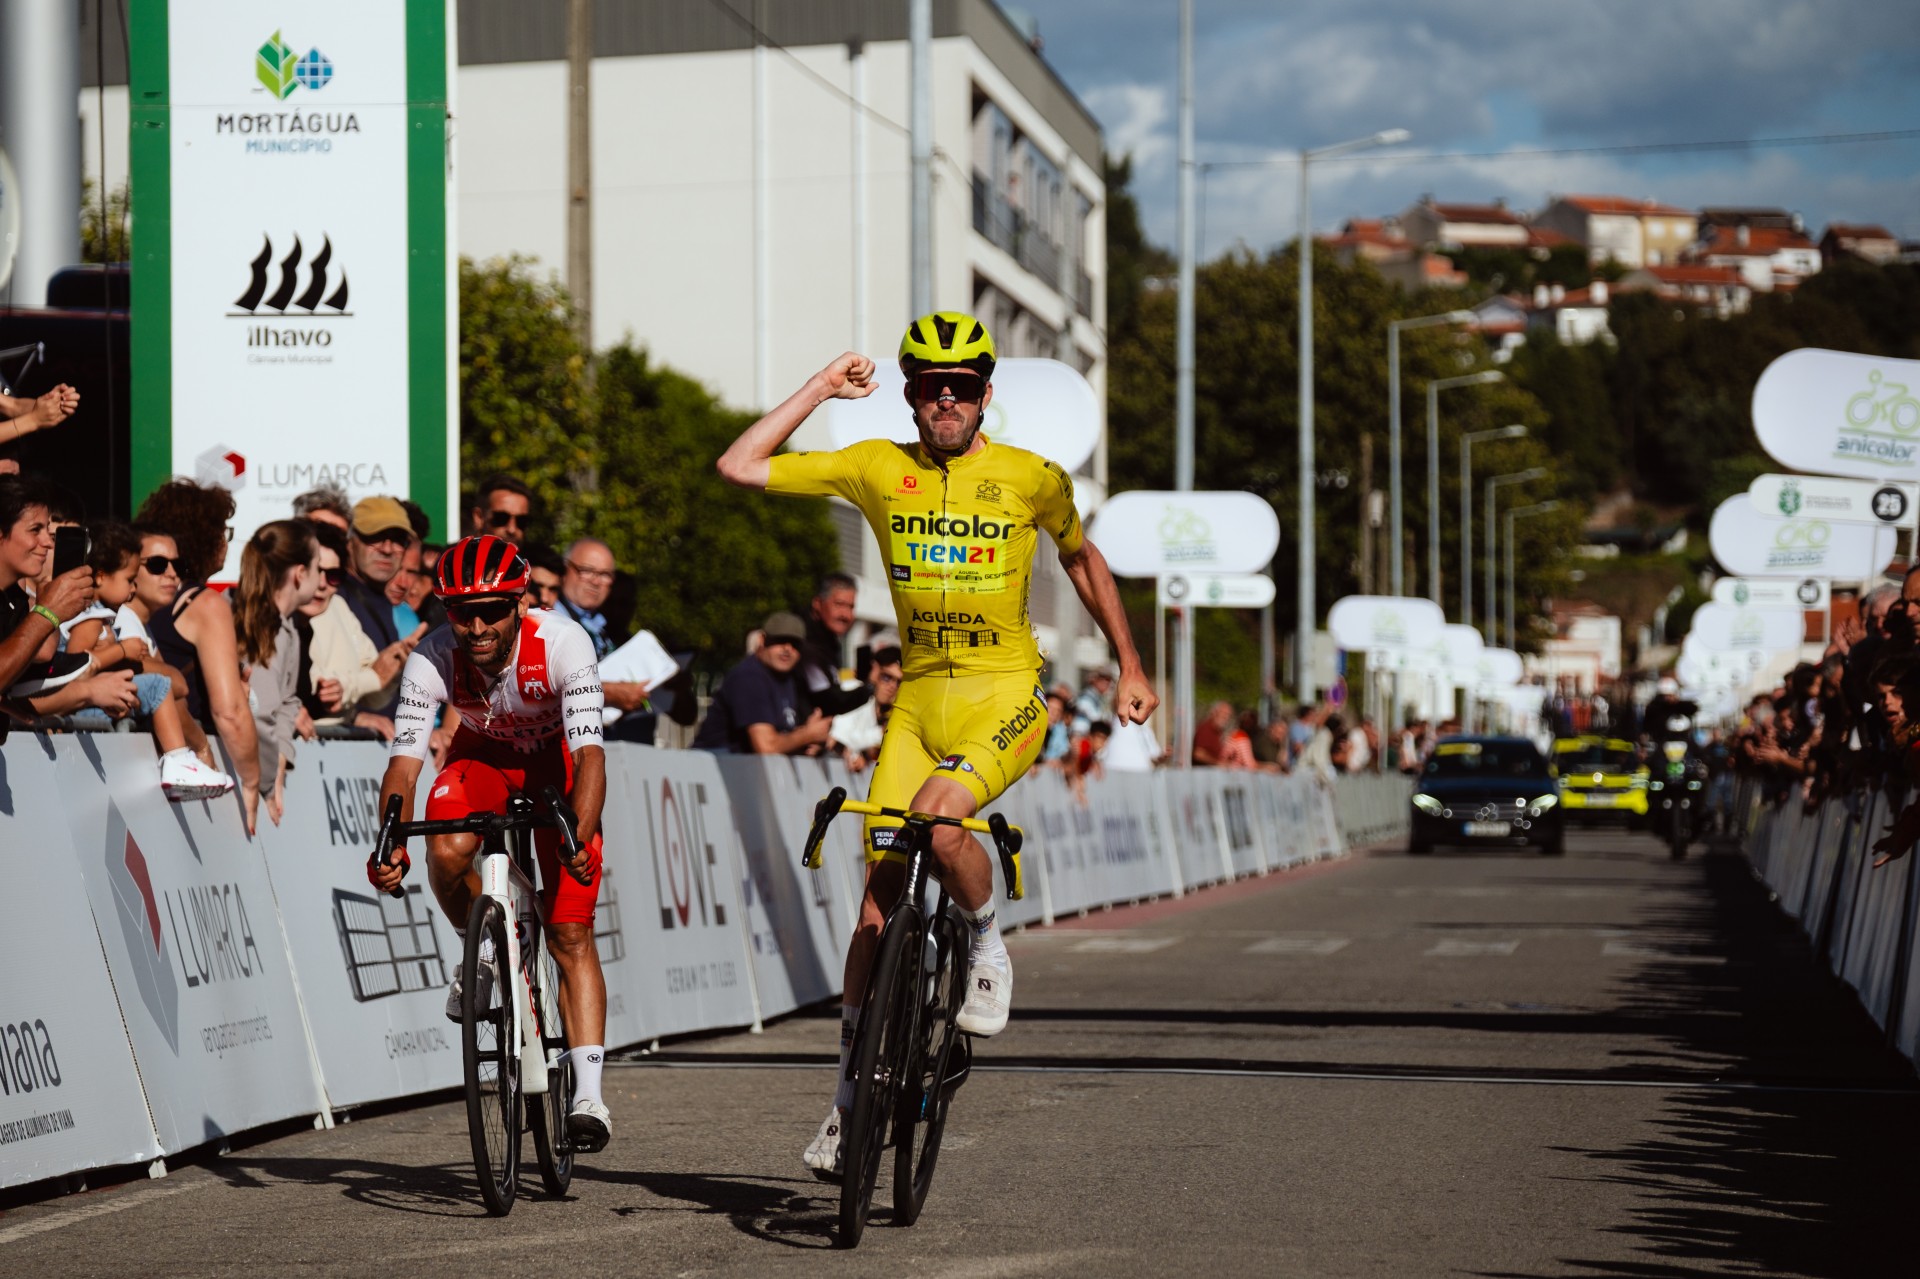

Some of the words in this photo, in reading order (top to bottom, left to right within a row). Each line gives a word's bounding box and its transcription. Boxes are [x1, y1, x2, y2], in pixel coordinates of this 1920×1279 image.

[216, 107, 361, 134] MORTÁGUA
[245, 135, 333, 153] MUNICÍPIO
[1836, 433, 1918, 462] anicolor
[257, 462, 389, 488] LUMARCA
[975, 492, 1001, 503] anicolor
[1876, 492, 1902, 517] 25
[891, 510, 1016, 540] anicolor
[911, 608, 986, 625] ÁGUEDA
[991, 699, 1040, 751] anicolor
[319, 759, 381, 846] ÁGUED
[876, 837, 909, 849] SOFAS
[164, 882, 264, 988] LUMARCA
[56, 1108, 76, 1131] VIANA
